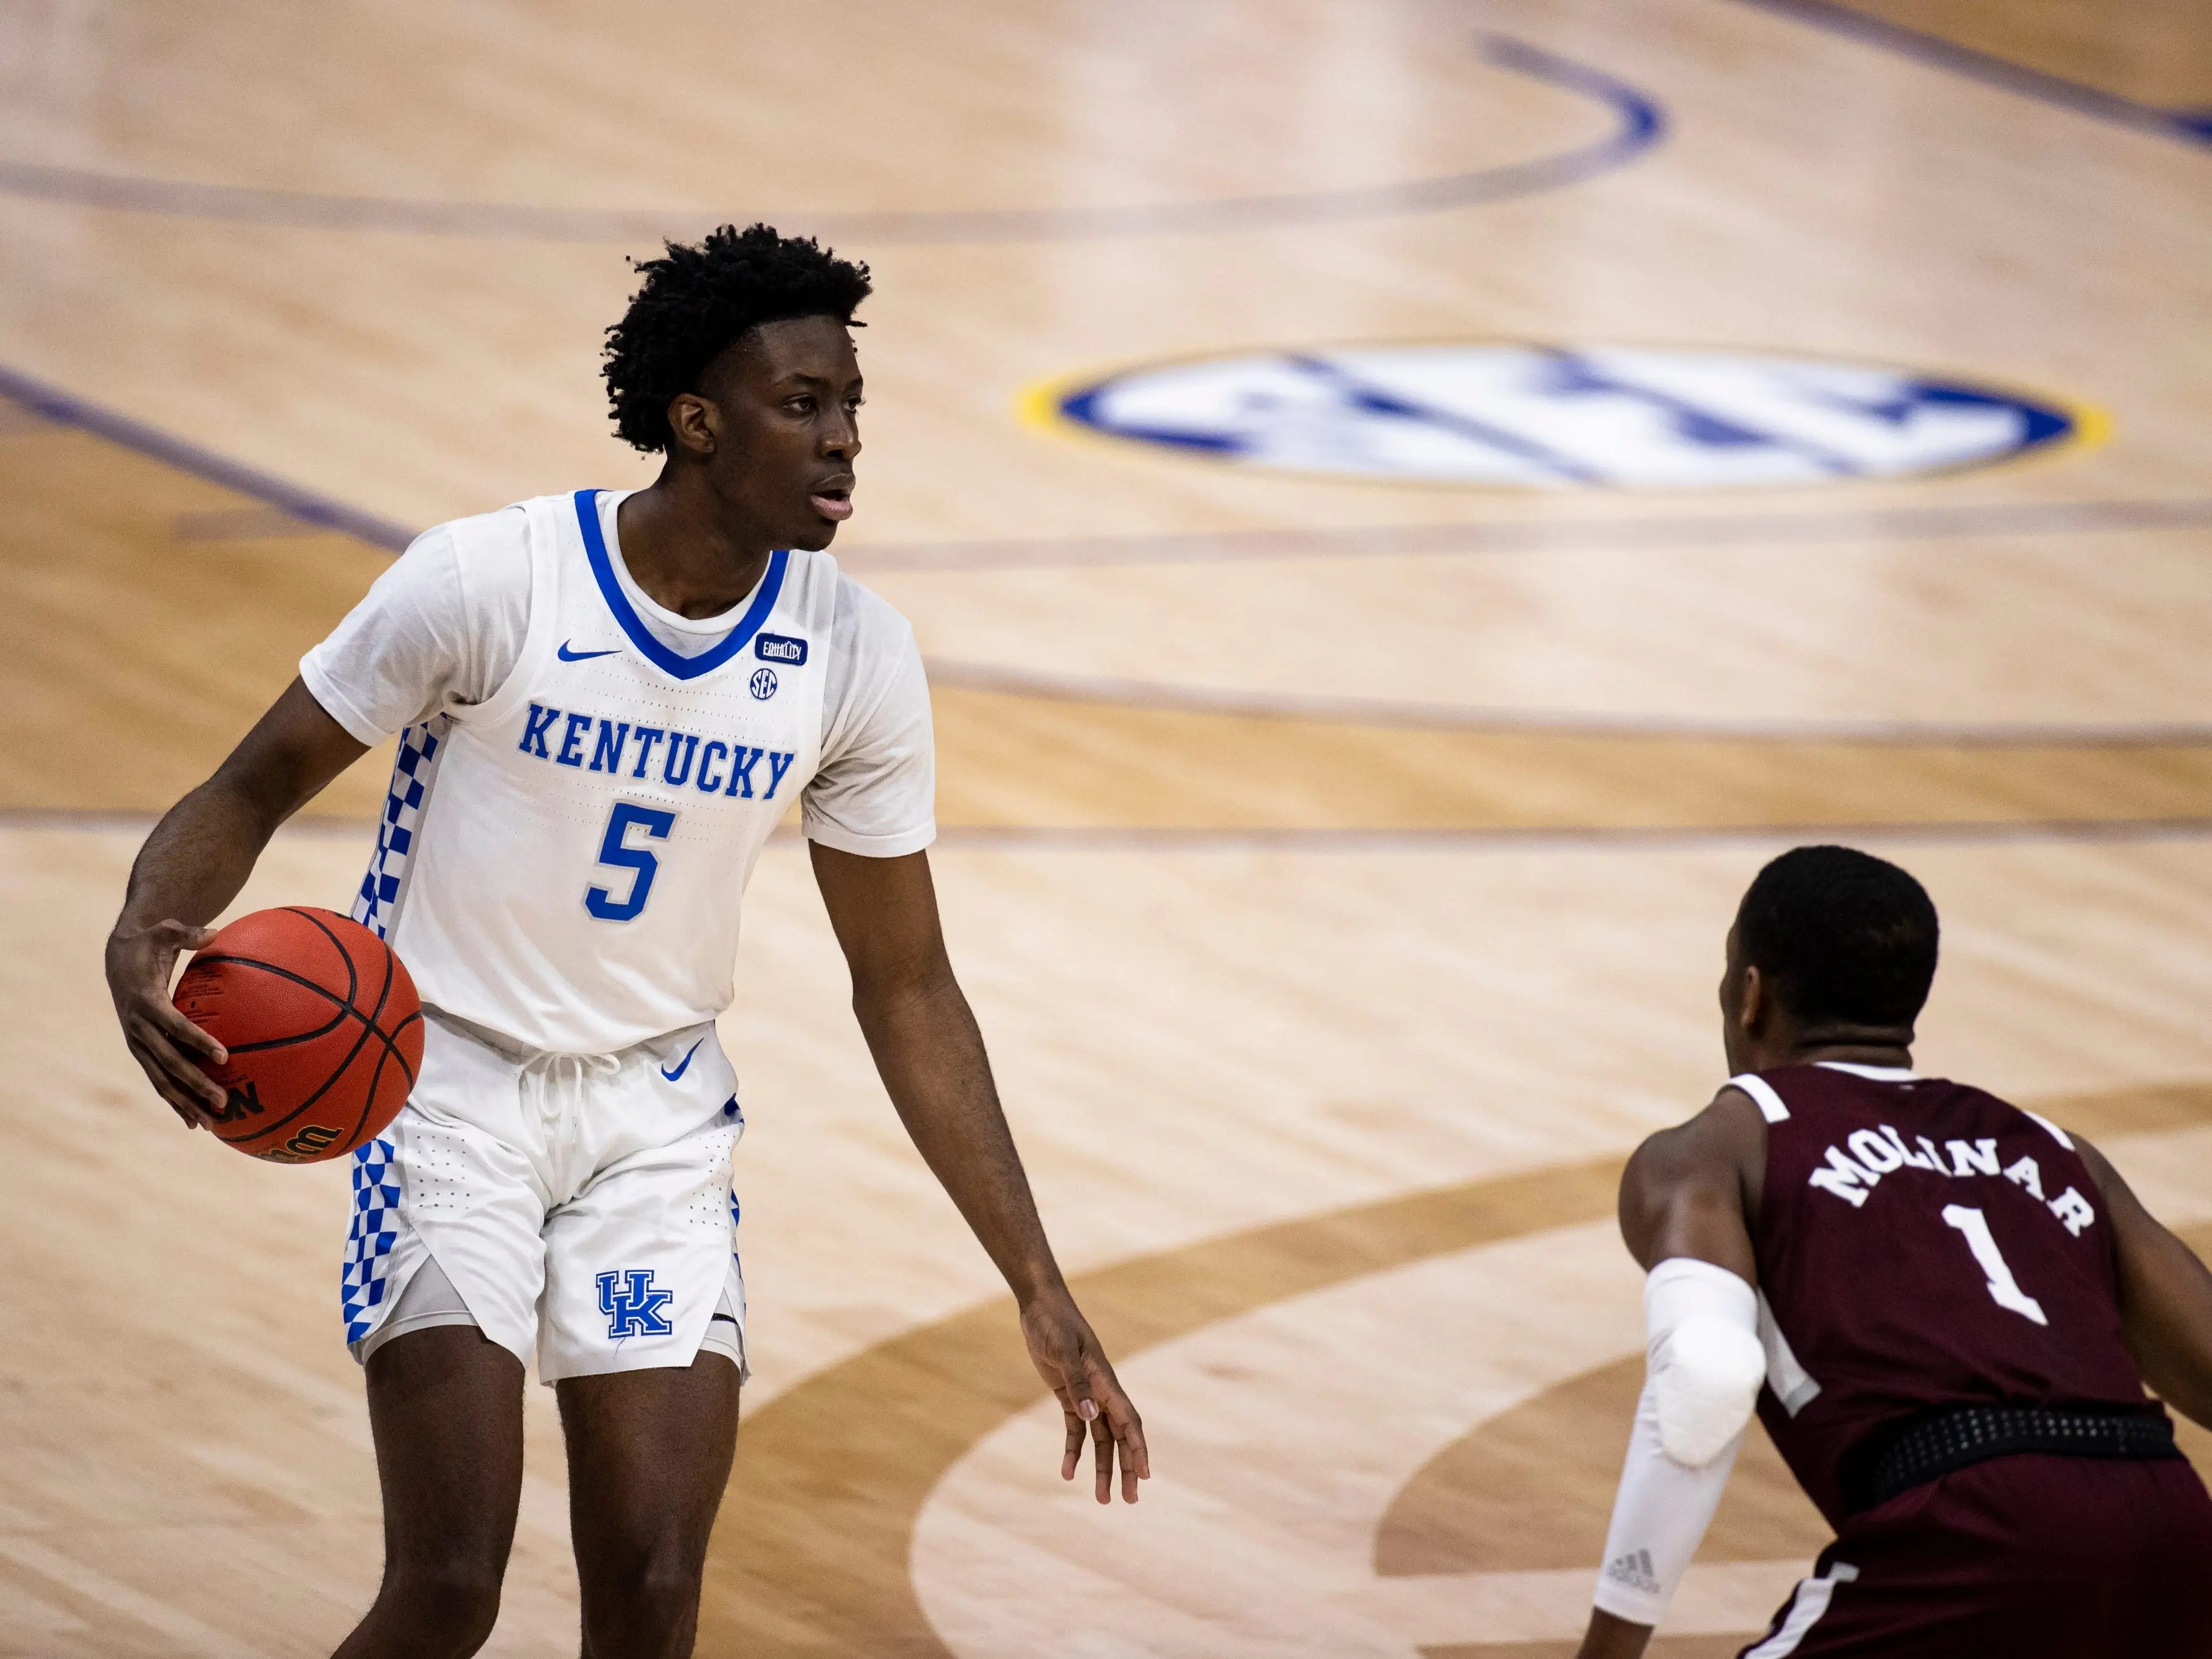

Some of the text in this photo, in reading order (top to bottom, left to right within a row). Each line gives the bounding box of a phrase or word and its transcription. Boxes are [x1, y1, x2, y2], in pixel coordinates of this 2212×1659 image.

[751, 669, 776, 699] SEC
[763, 641, 802, 660] EQUALITY
[518, 701, 796, 801] KENTUCKY
[581, 799, 680, 925] 5
[1808, 1124, 2095, 1237] MOLINAR
[596, 1270, 673, 1339] UK
[1942, 1203, 2049, 1326] 1
